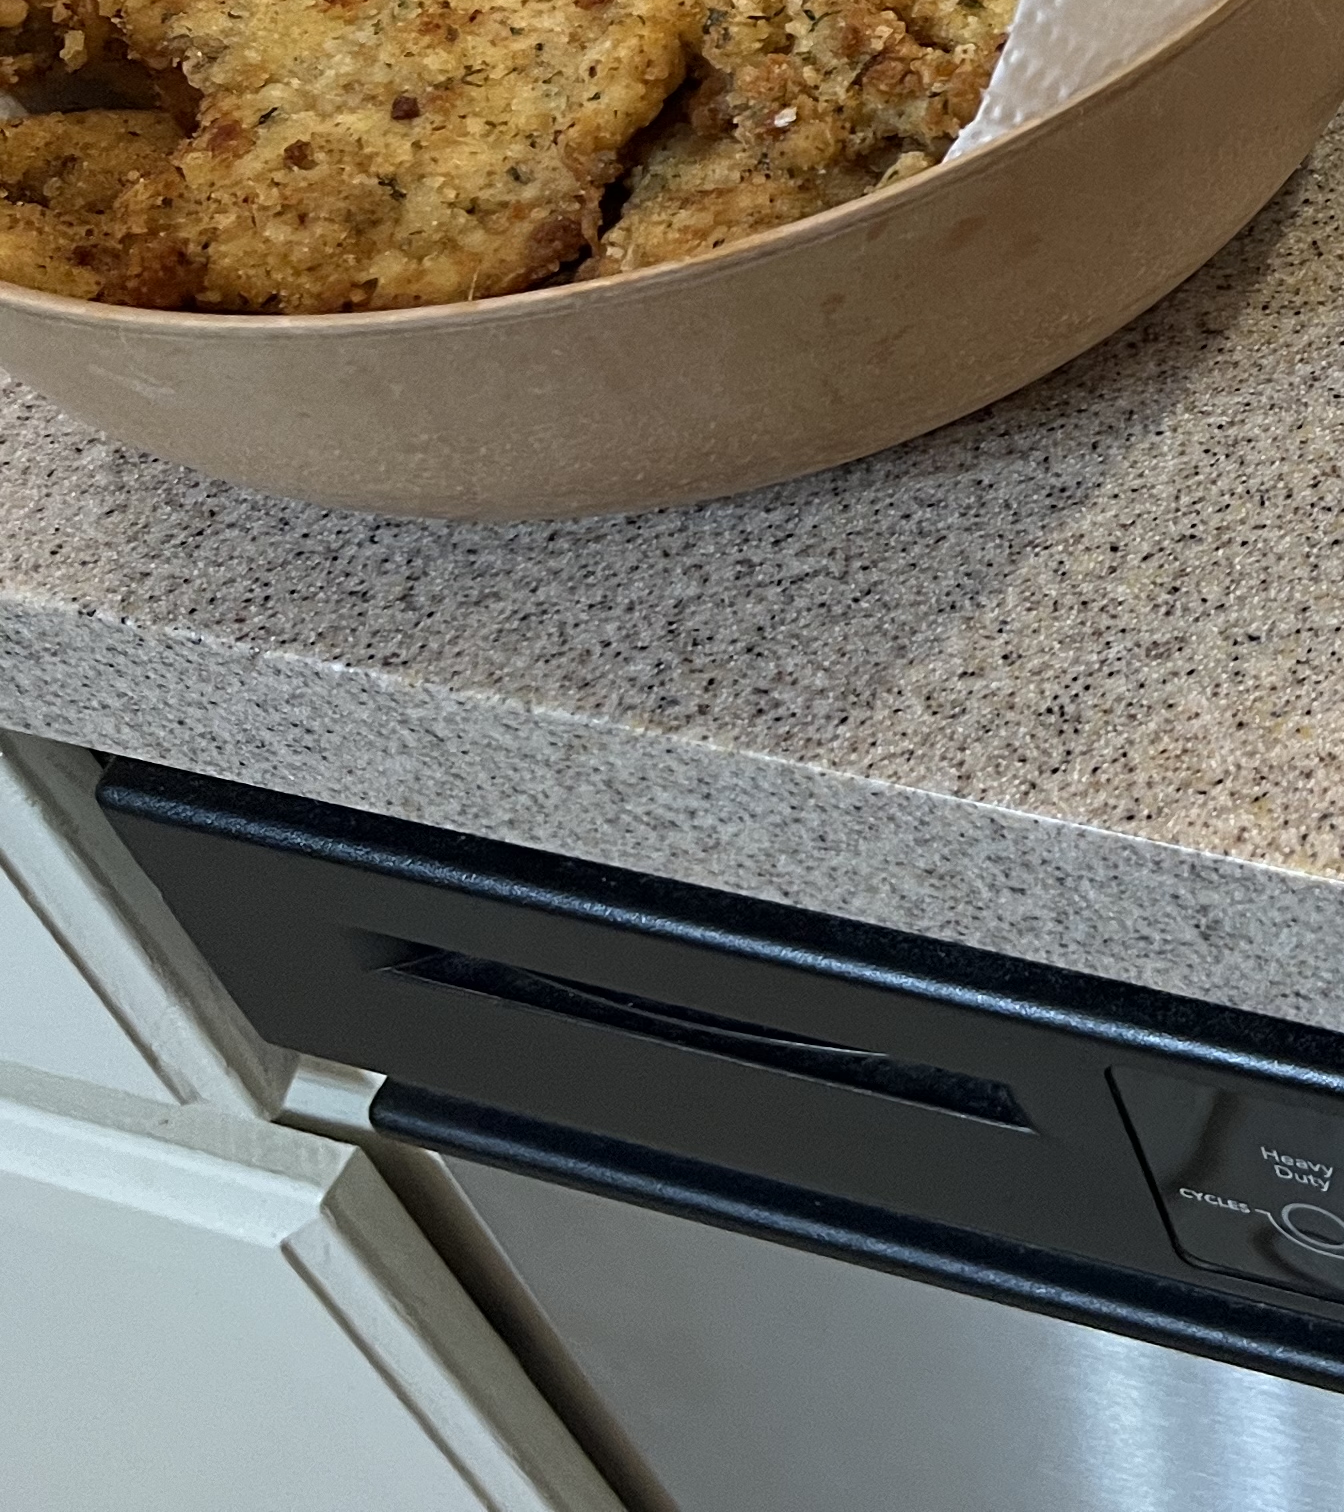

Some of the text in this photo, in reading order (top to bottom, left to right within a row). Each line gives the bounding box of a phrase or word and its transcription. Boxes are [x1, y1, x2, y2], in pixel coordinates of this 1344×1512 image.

[1260, 1146, 1334, 1179] Heavy
[1273, 1163, 1332, 1192] Duty
[1178, 1187, 1251, 1214] CYCLES
